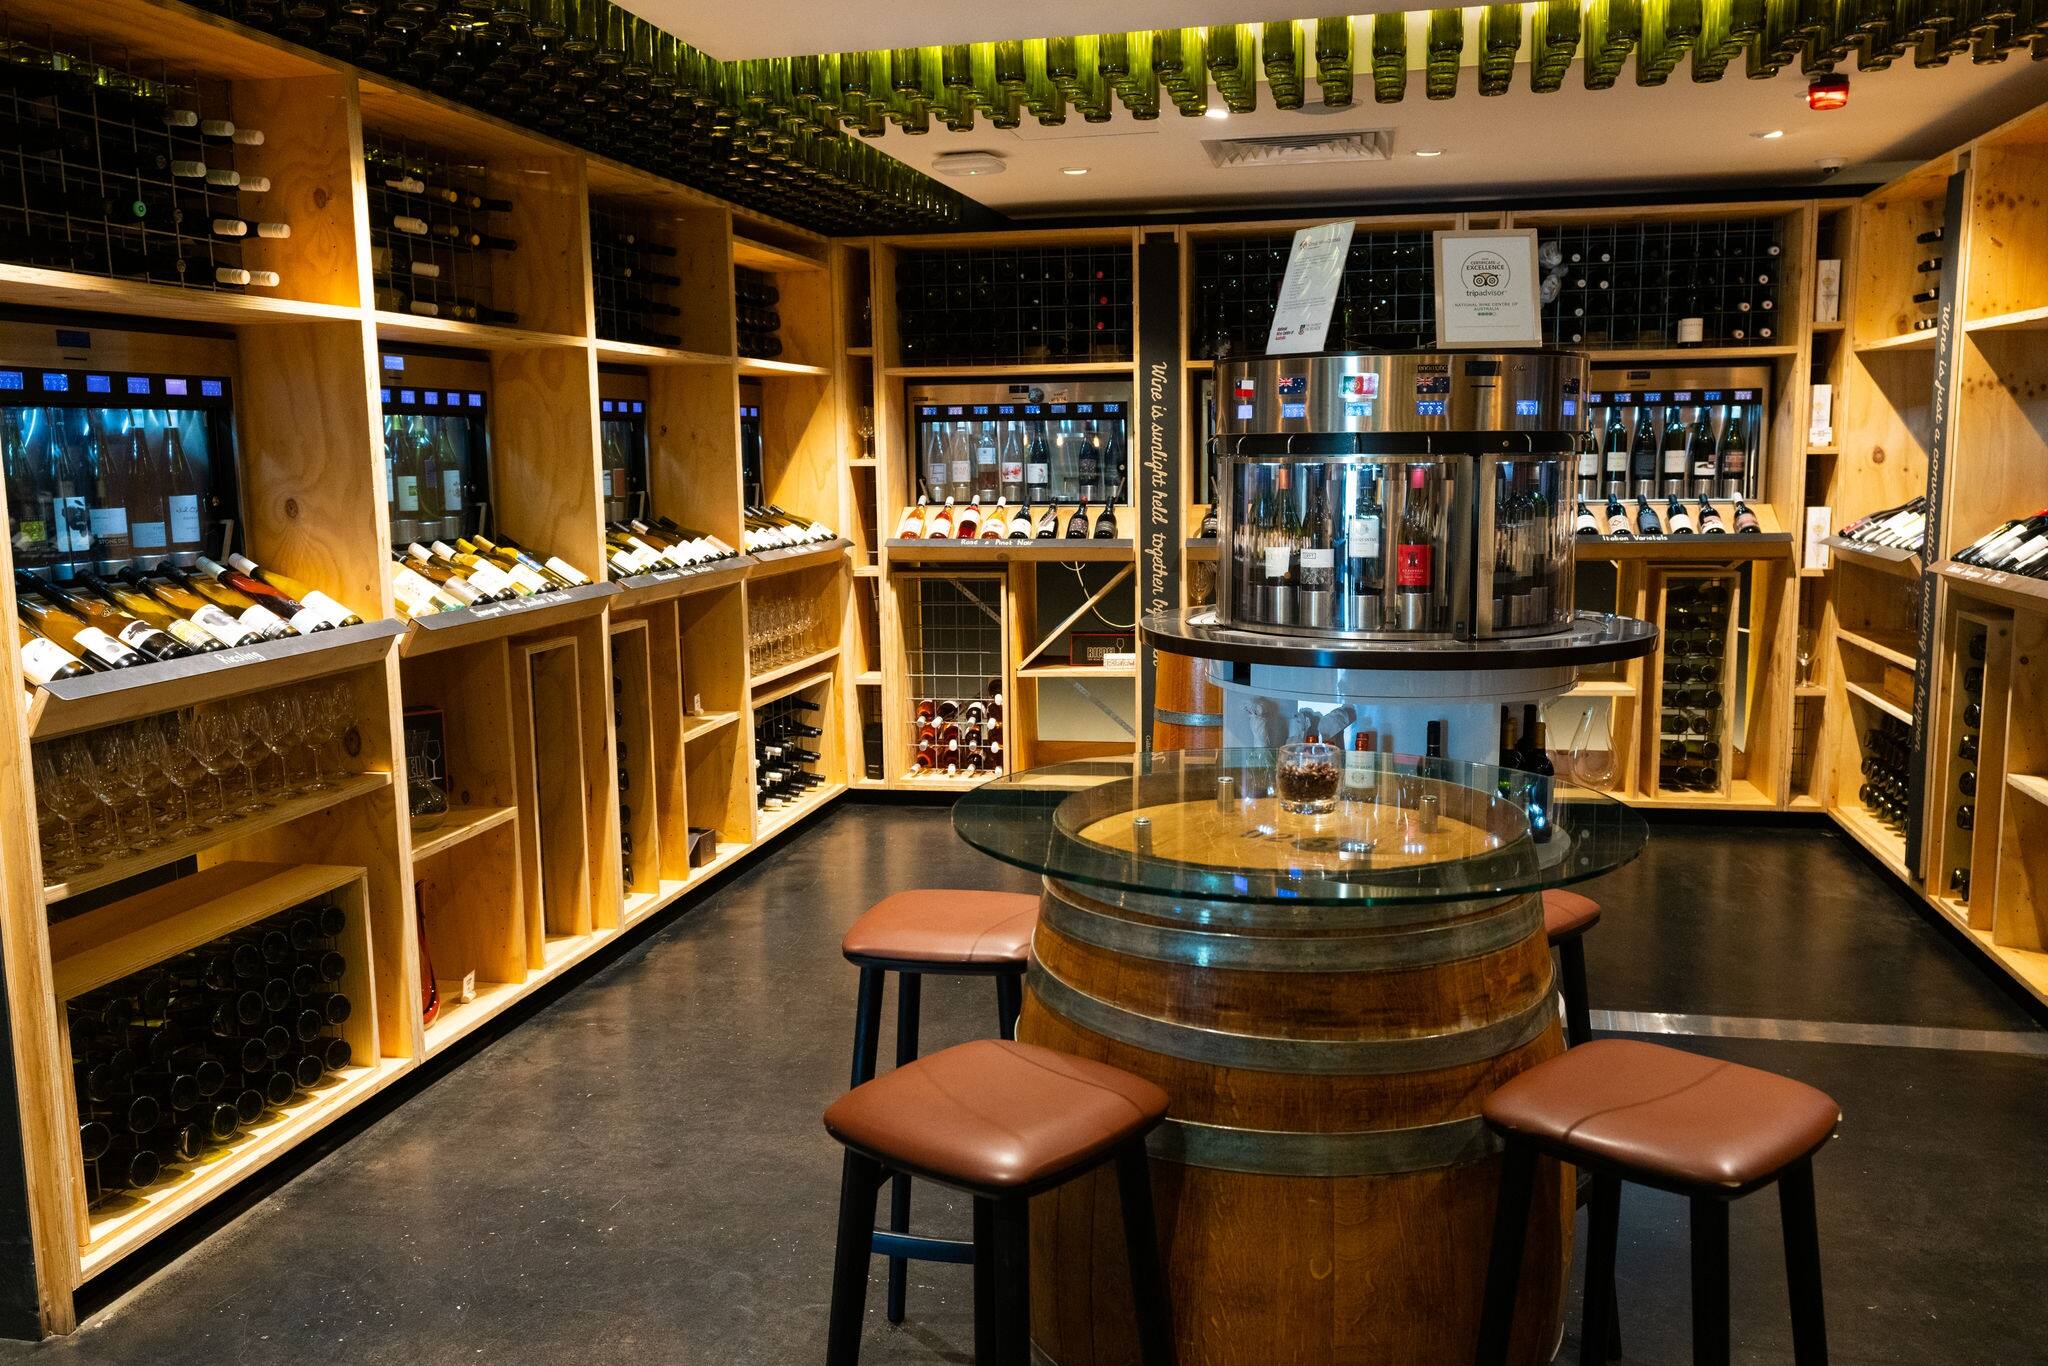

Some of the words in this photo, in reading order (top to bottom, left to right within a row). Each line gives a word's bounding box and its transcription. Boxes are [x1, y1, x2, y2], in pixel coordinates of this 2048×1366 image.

[1466, 290, 1505, 298] tripadvisor
[1151, 361, 1168, 401] Wine
[1938, 360, 1947, 380] is
[1151, 405, 1168, 420] is
[1935, 379, 1945, 424] just
[1934, 428, 1941, 443] a
[1144, 422, 1168, 487] sunlight
[1152, 490, 1168, 525] held
[995, 538, 1013, 546] Pinot
[1145, 532, 1168, 596] together
[1918, 580, 1931, 652] waiting
[213, 651, 266, 664] Riesling
[1919, 658, 1928, 683] to
[1913, 685, 1926, 752] happen
